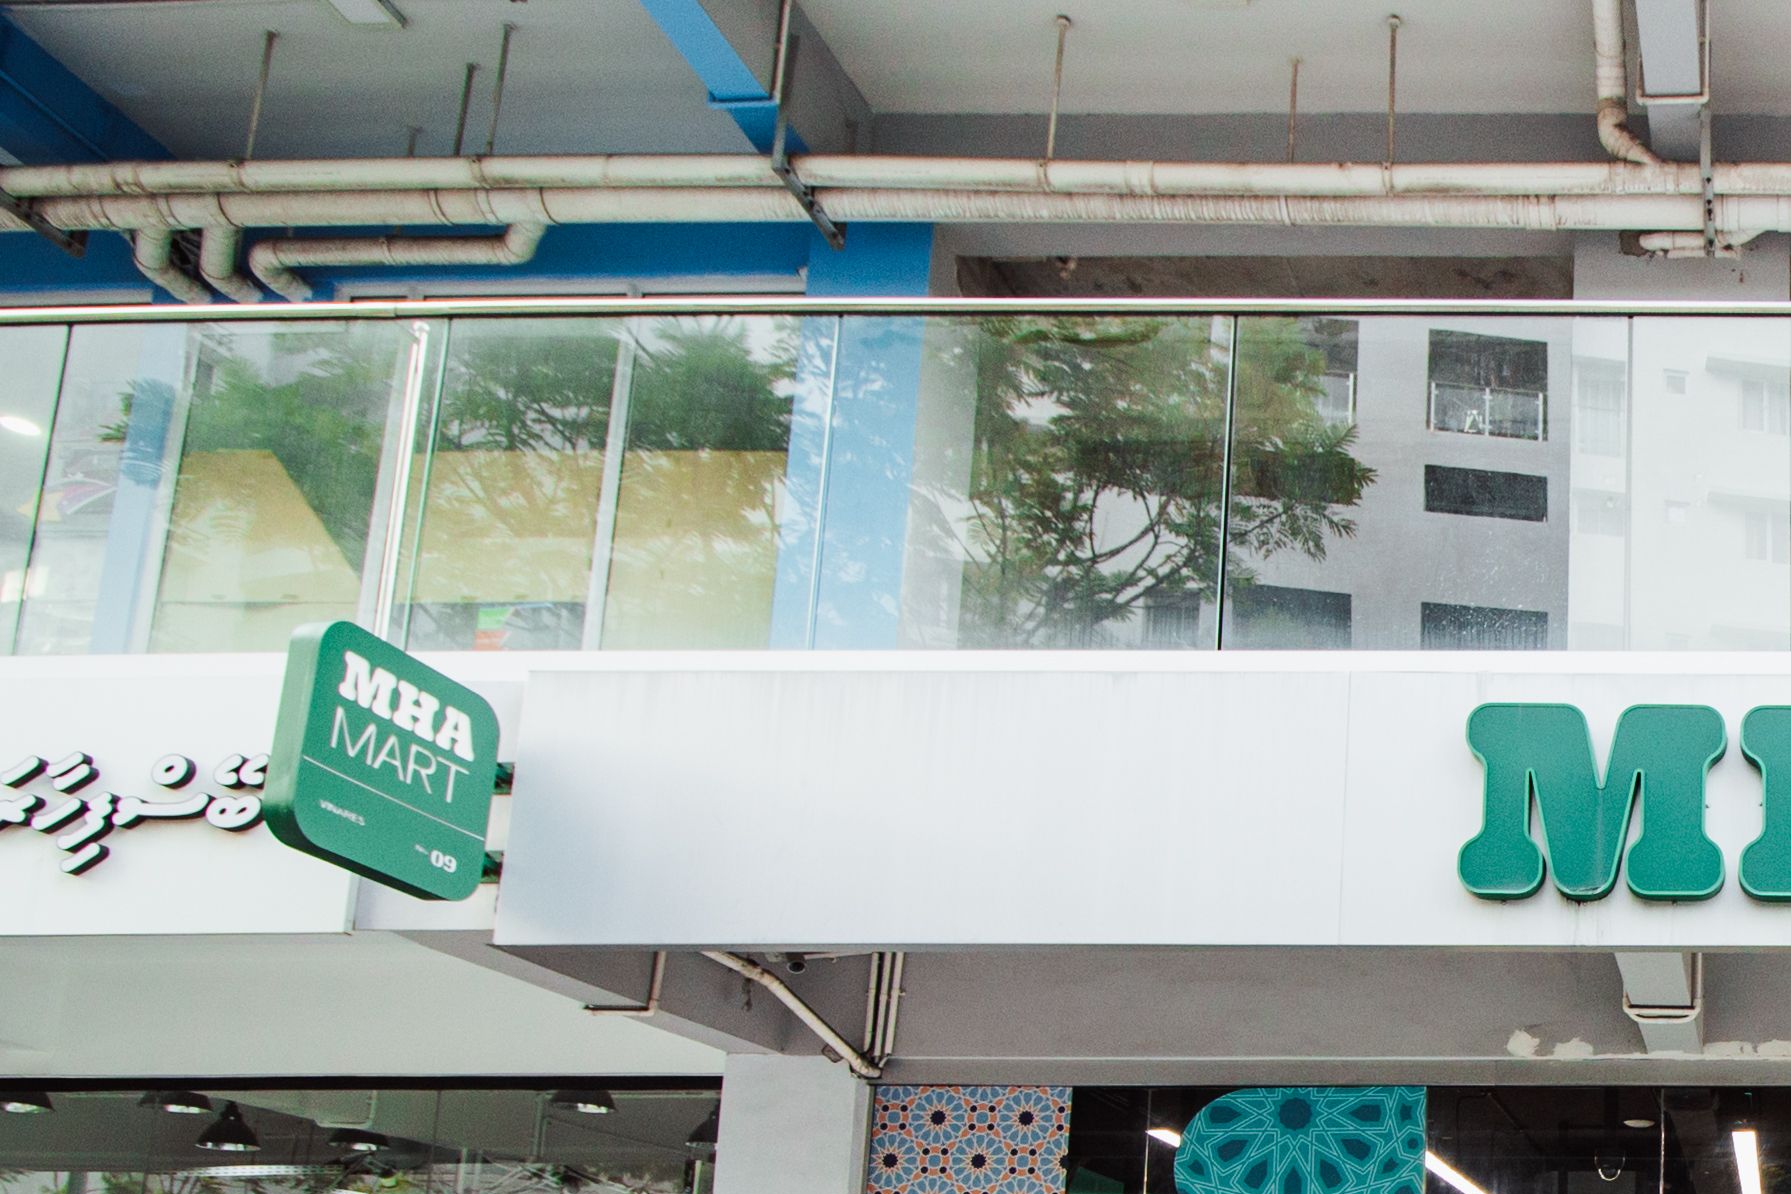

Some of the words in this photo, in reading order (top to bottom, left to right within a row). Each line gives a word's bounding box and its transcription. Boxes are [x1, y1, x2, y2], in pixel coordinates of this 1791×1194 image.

[330, 705, 470, 804] MART
[338, 650, 475, 762] MHA
[430, 850, 457, 873] 09
